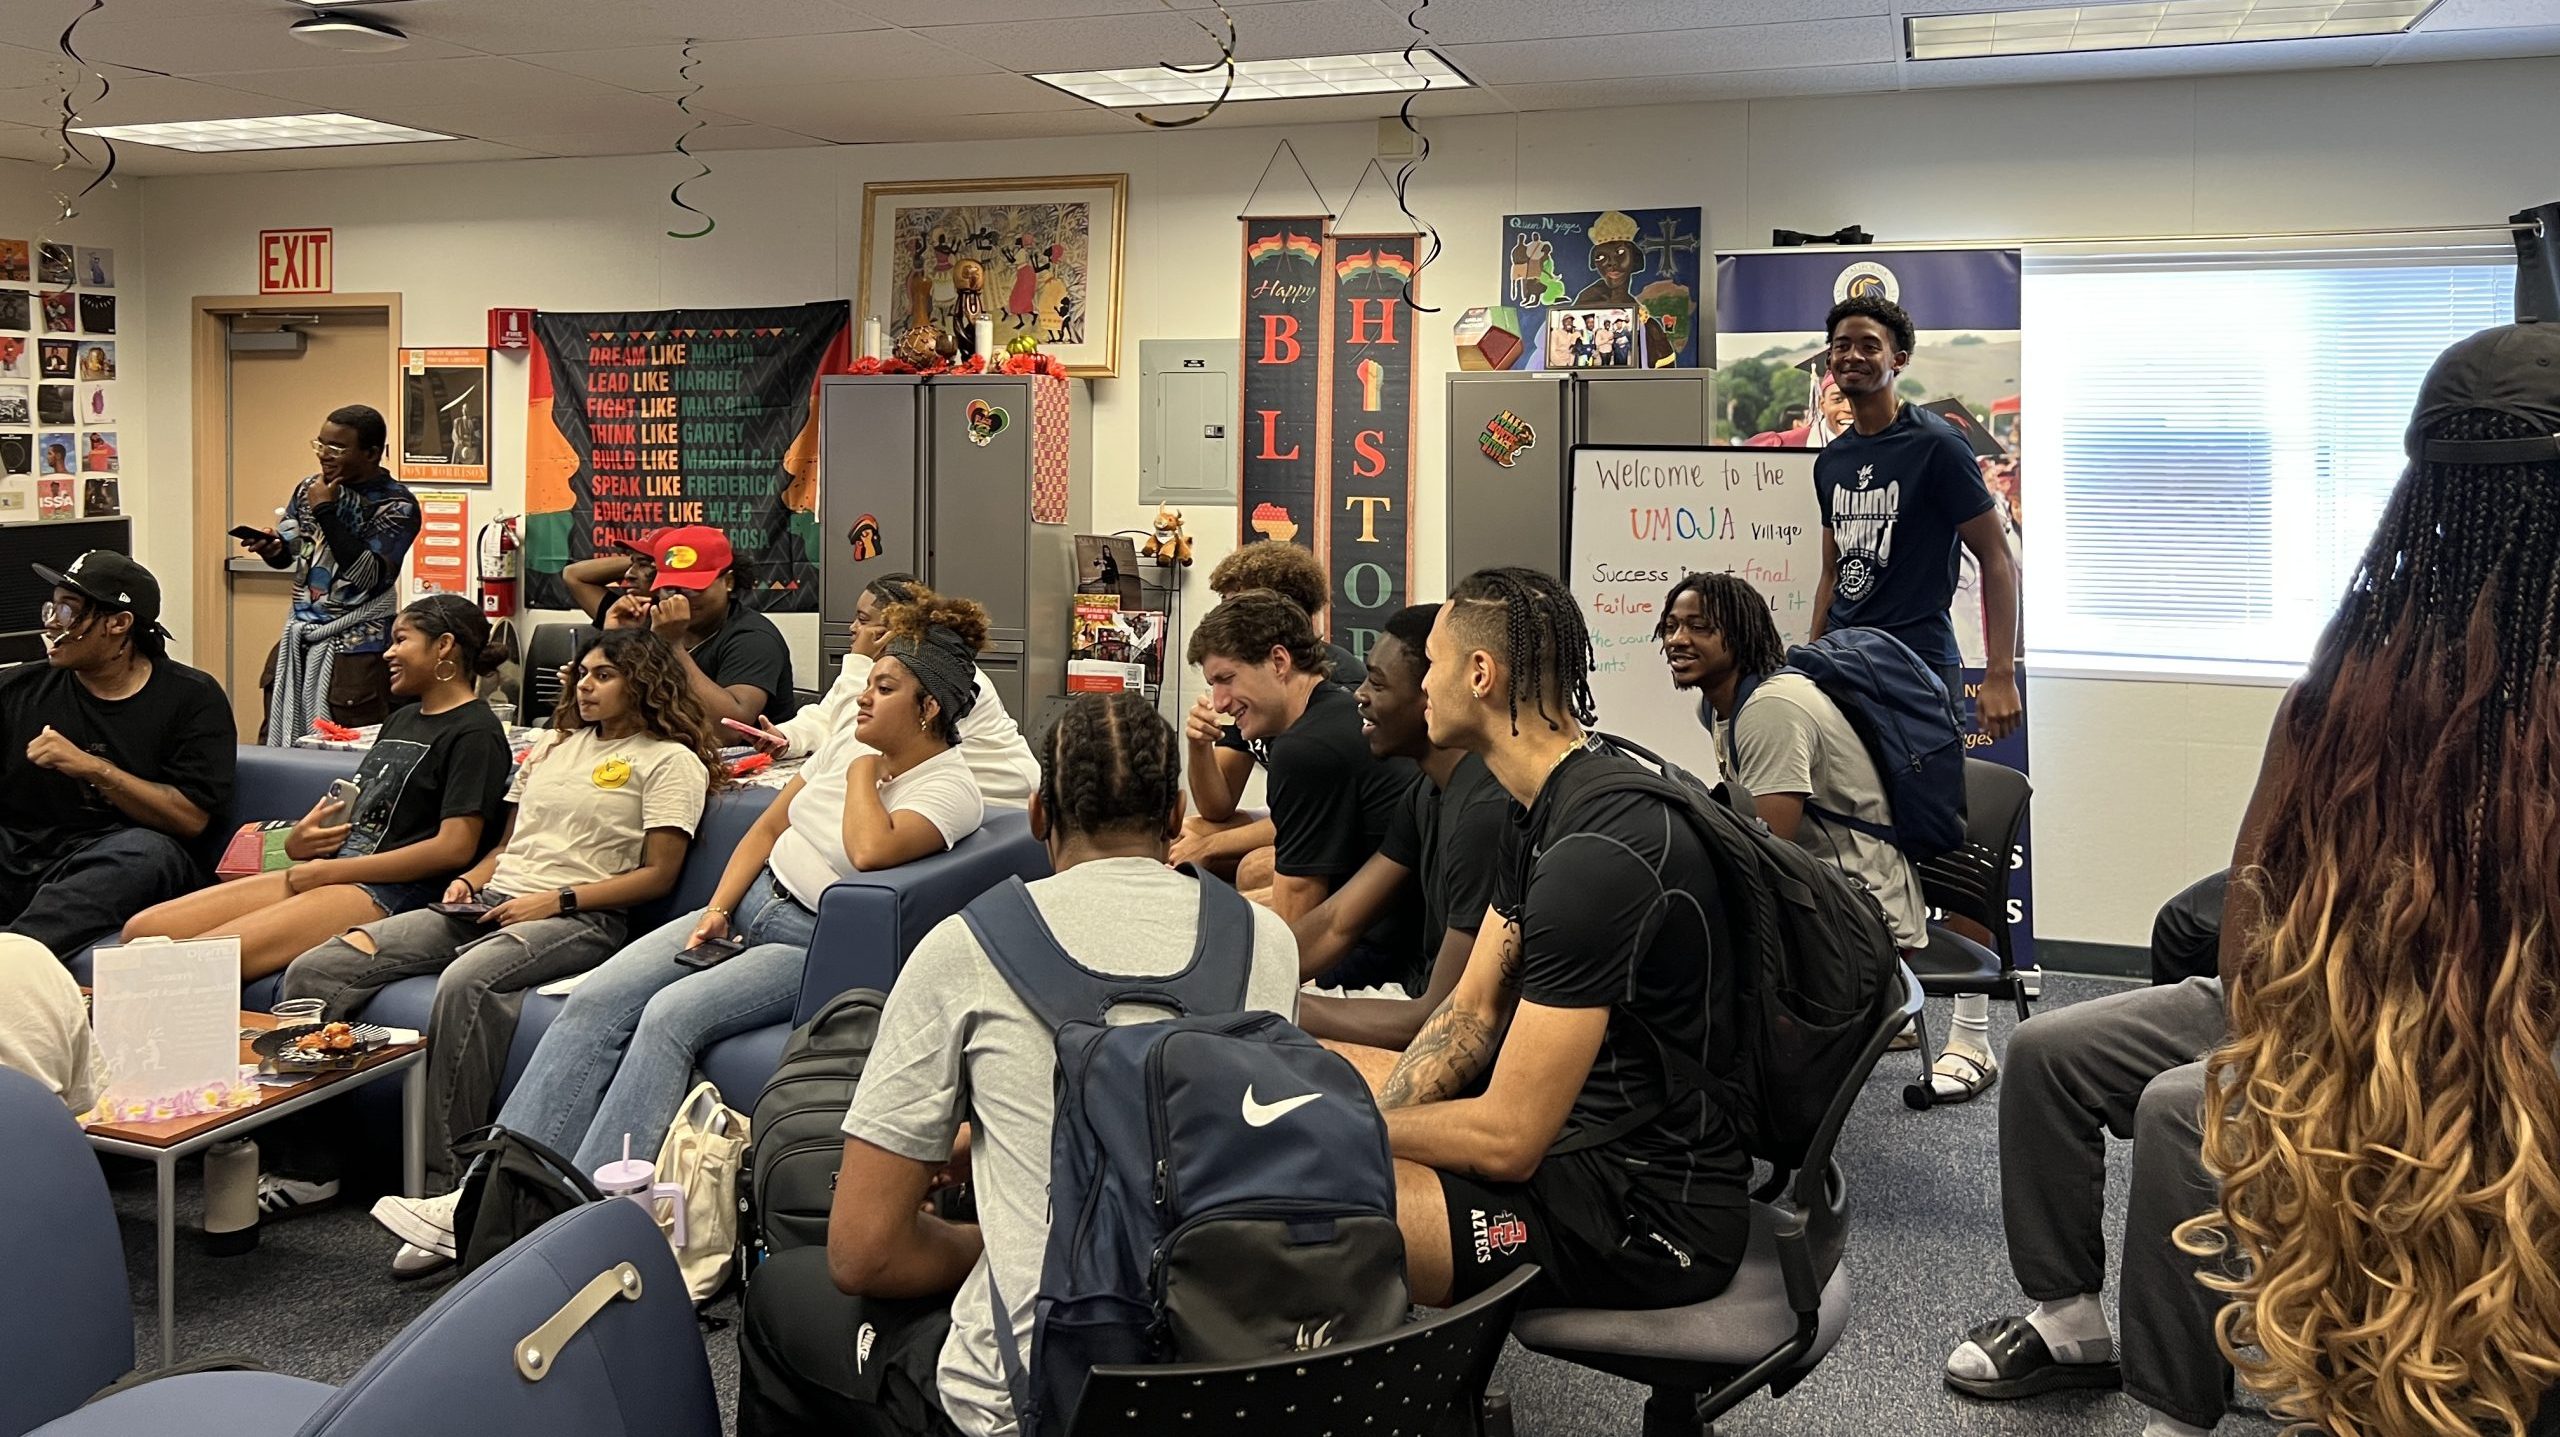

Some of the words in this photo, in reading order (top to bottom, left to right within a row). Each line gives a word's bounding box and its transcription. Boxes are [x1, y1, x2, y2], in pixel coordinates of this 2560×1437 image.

[264, 236, 328, 289] EXIT
[1251, 279, 1317, 304] Happy
[588, 346, 646, 367] DREAM
[651, 344, 686, 366] LIKE
[691, 344, 754, 365] MARTIN
[587, 372, 629, 393] LEAD
[633, 371, 670, 392] LIKE
[674, 370, 743, 391] HARRIET
[587, 397, 636, 419] FIGHT
[640, 397, 677, 418] LIKE
[681, 396, 762, 418] MALCOLM
[589, 423, 636, 445] THINK
[641, 423, 678, 444] LIKE
[682, 423, 745, 444] GARVEY
[592, 450, 636, 471] BUILD
[641, 449, 678, 470] LIKE
[683, 449, 745, 470] MADAM
[750, 448, 776, 470] C.J
[401, 466, 426, 477] TONI
[431, 466, 486, 477] MORRISON
[1596, 459, 1704, 491] Welcome
[1721, 459, 1740, 491] to
[1752, 461, 1785, 491] the
[591, 476, 640, 497] SPEAK
[646, 476, 681, 497] LIKE
[686, 475, 778, 497] FREDERICK
[39, 495, 74, 508] ISSA
[593, 501, 662, 523] EDUCATE
[668, 501, 704, 523] LIKE
[708, 501, 752, 523] W.E.B
[1630, 506, 1735, 541] UMOJA
[1751, 522, 1802, 545] Village
[730, 528, 770, 549] ROSA
[1592, 563, 1669, 583] Success
[1593, 593, 1653, 614] failure
[1619, 633, 1653, 645] cour
[1470, 1209, 1492, 1264] AZTECS
[860, 1329, 877, 1362] NIKE
